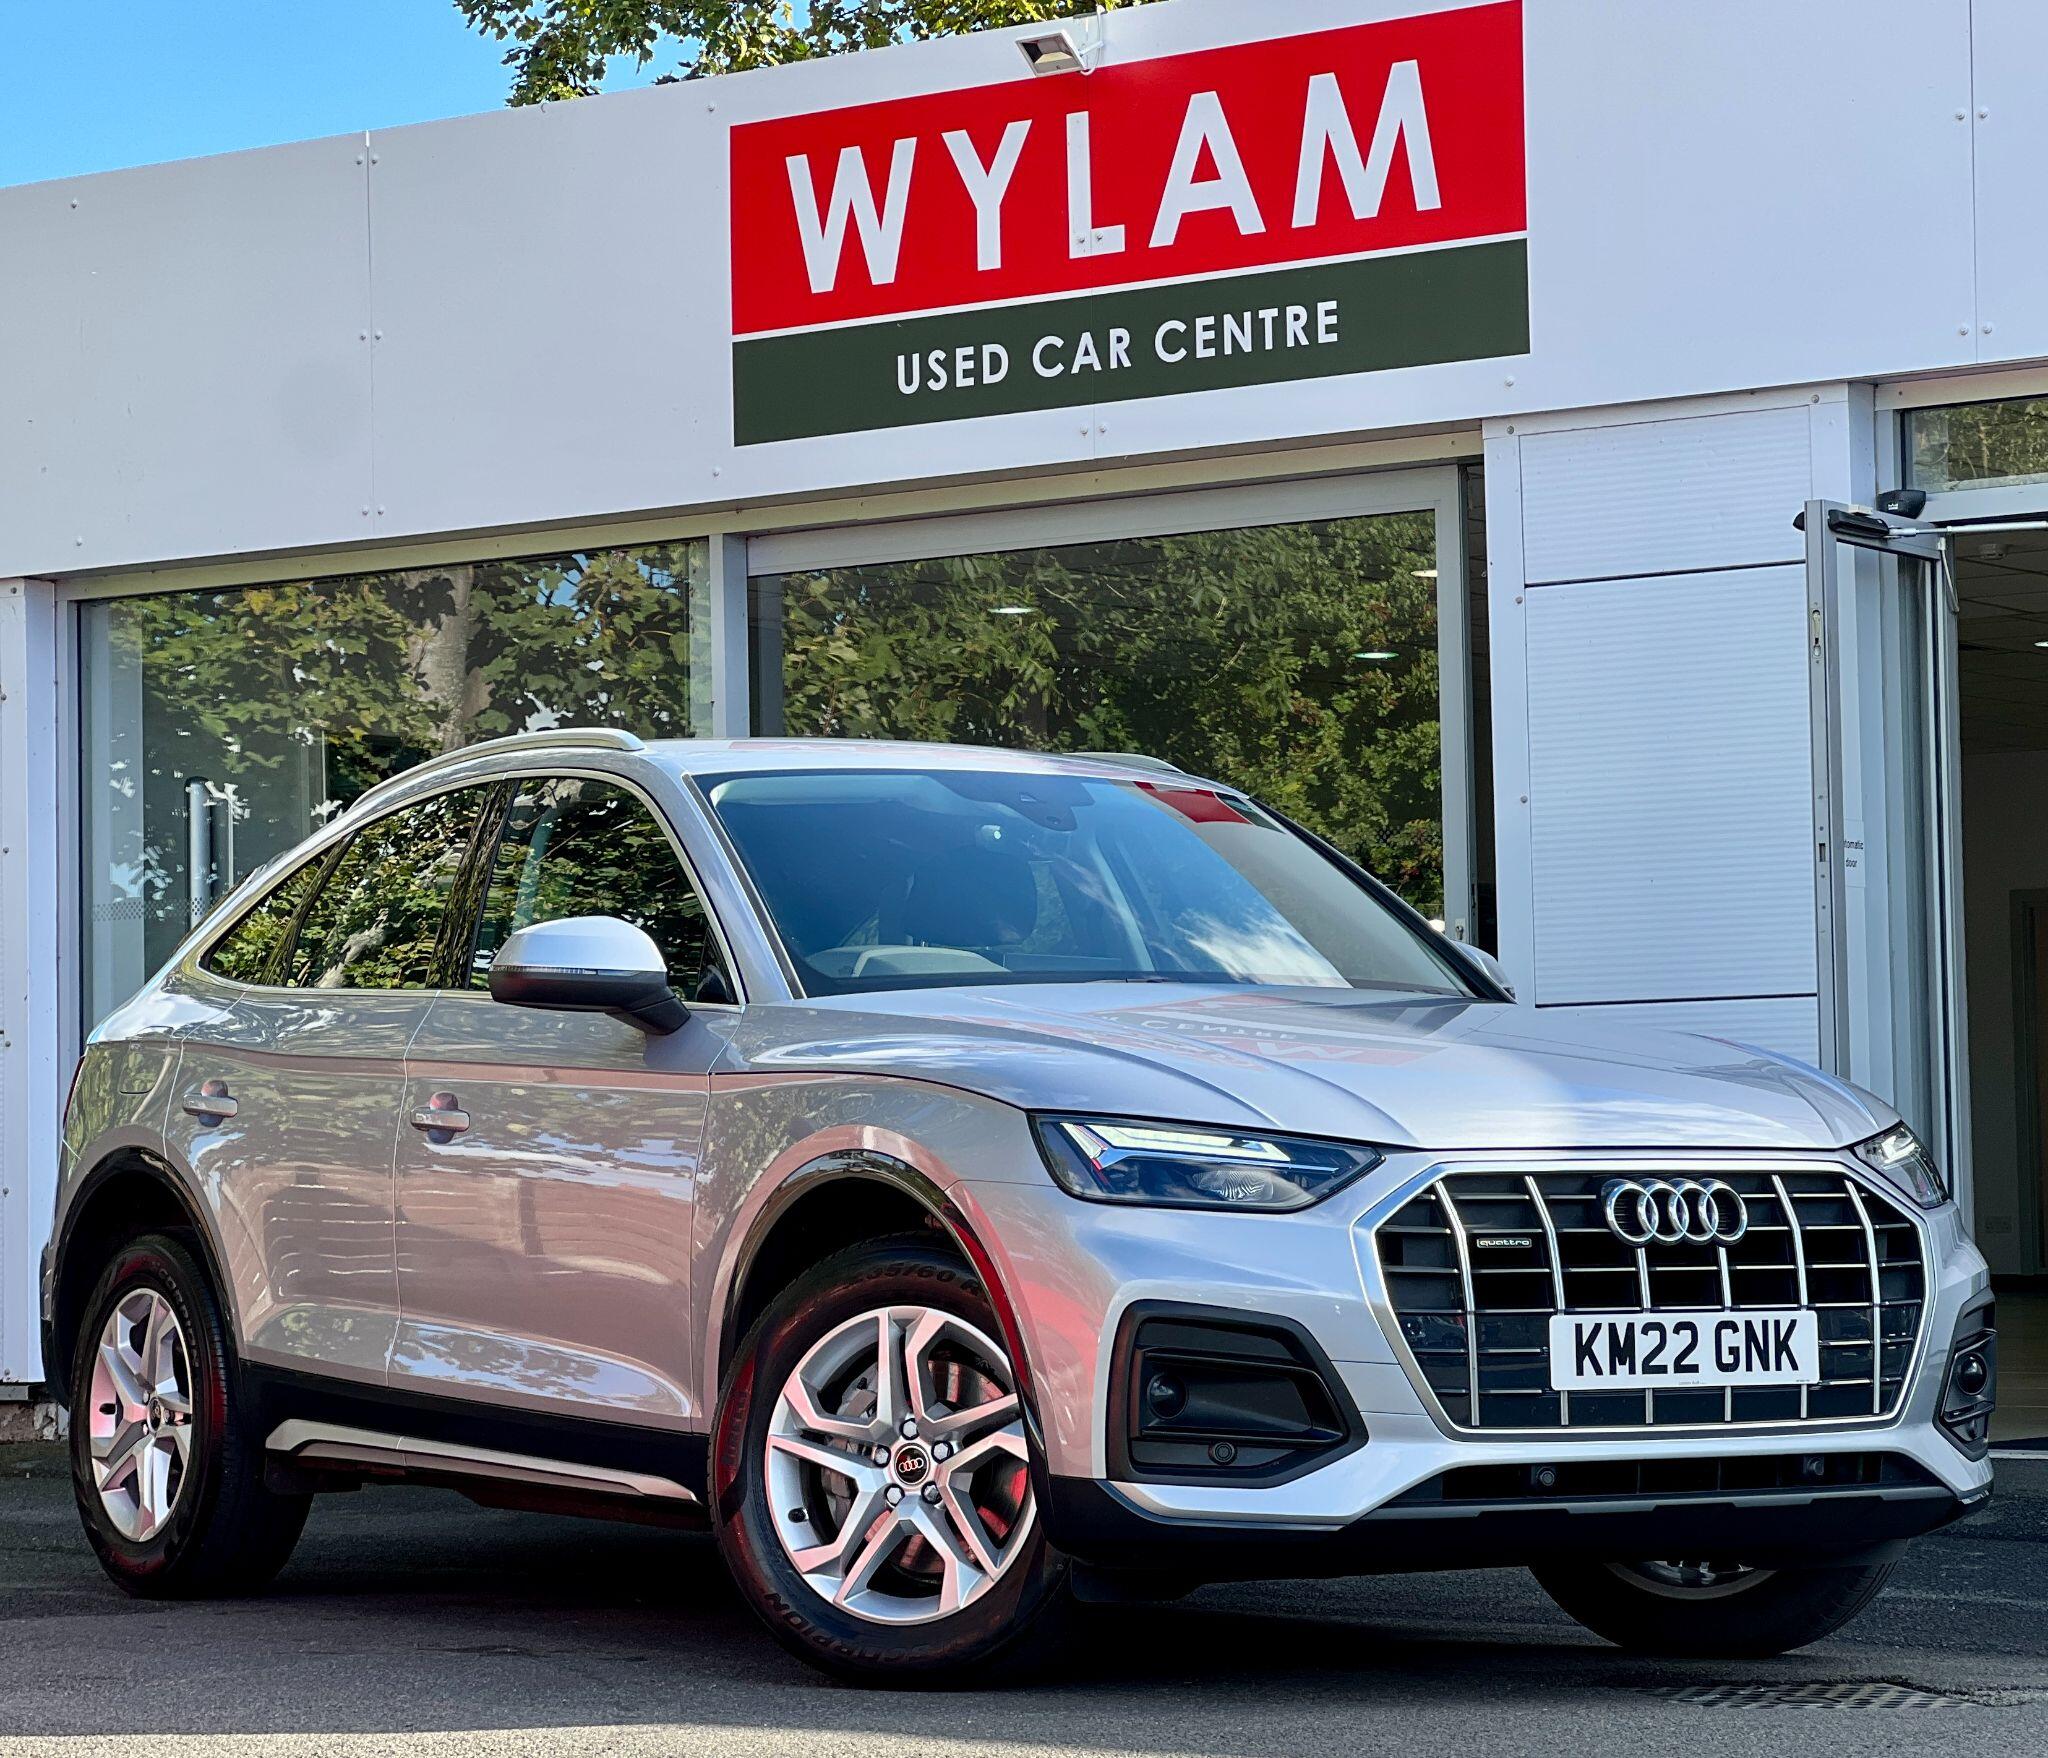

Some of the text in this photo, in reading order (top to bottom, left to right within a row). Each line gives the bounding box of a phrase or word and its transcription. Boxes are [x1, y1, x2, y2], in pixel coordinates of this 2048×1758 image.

[786, 60, 1441, 293] WYLAM
[897, 301, 1338, 394] USED CAR CENTRE
[1480, 1239, 1530, 1247] quattro
[1575, 1318, 1799, 1377] KM22 GNK
